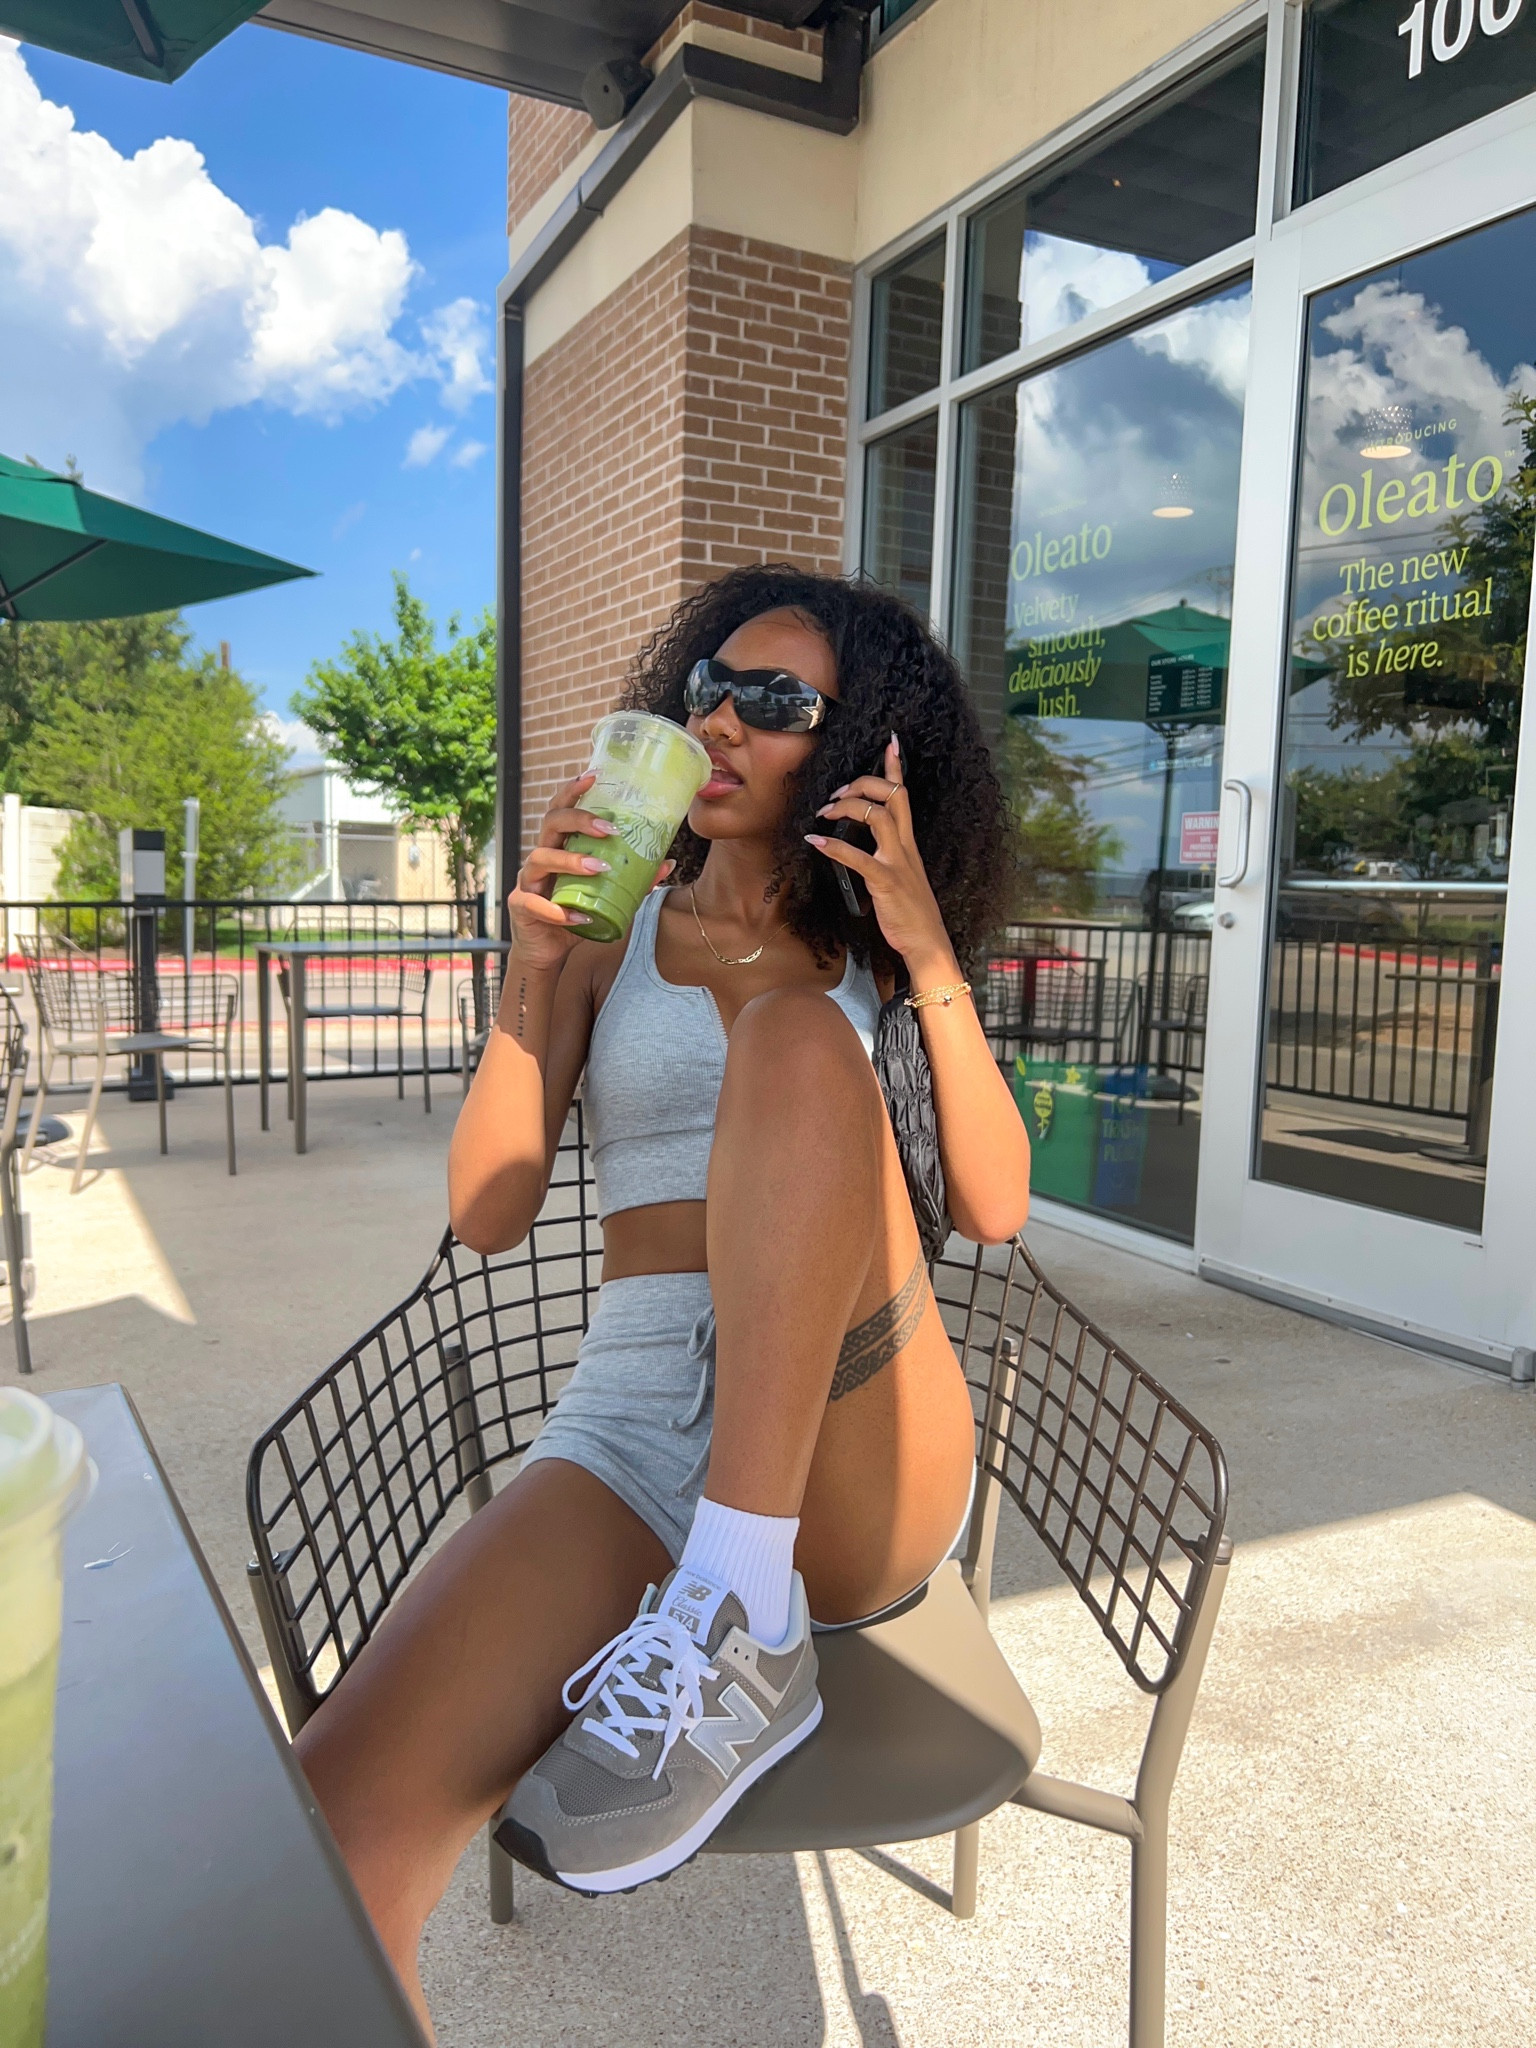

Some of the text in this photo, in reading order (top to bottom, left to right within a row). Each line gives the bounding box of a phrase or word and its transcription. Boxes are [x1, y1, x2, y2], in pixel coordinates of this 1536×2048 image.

[1318, 453, 1503, 537] Oleato
[1010, 522, 1113, 581] Oleato
[1339, 546, 1469, 596] The new
[1012, 593, 1079, 629] Velvety
[1313, 576, 1493, 641] coffee ritual
[1027, 615, 1106, 658] smooth,
[1346, 638, 1443, 678] is here.
[1009, 649, 1102, 693] deliciously
[1037, 687, 1081, 720] lush.
[1184, 815, 1220, 830] WARNIN
[673, 1610, 694, 1630] 574
[685, 1681, 770, 1779] N
